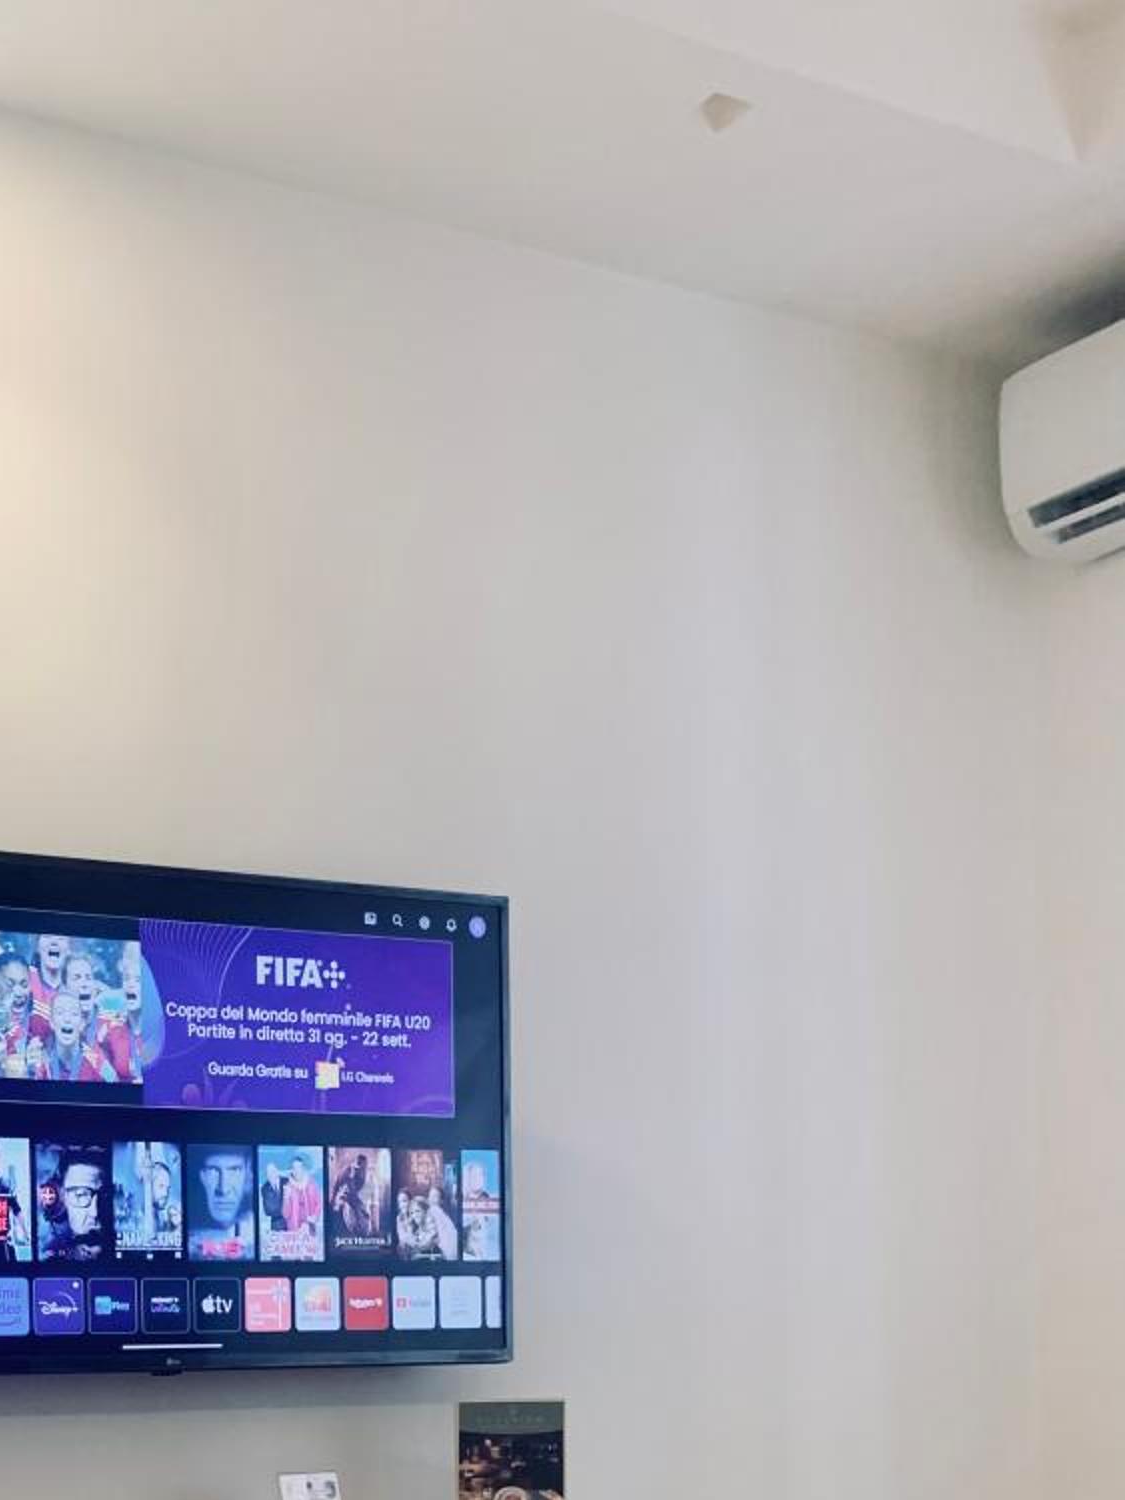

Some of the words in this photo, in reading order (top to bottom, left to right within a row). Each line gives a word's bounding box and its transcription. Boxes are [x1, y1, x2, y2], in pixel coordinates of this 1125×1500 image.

[165, 1001, 218, 1023] Coppa
[220, 1004, 244, 1021] del
[248, 1007, 298, 1023] Mondo
[300, 1008, 373, 1027] femminile
[374, 1013, 402, 1029] FIFA
[404, 1015, 431, 1030] U20
[188, 1022, 236, 1040] Partite
[240, 1024, 253, 1040] in
[256, 1025, 304, 1043] diretta
[307, 1028, 321, 1043] 31
[362, 1032, 379, 1046] 22
[381, 1033, 412, 1048] sett.
[207, 1061, 254, 1078] Guarda
[255, 1063, 292, 1079] Gratis
[294, 1066, 308, 1080] su
